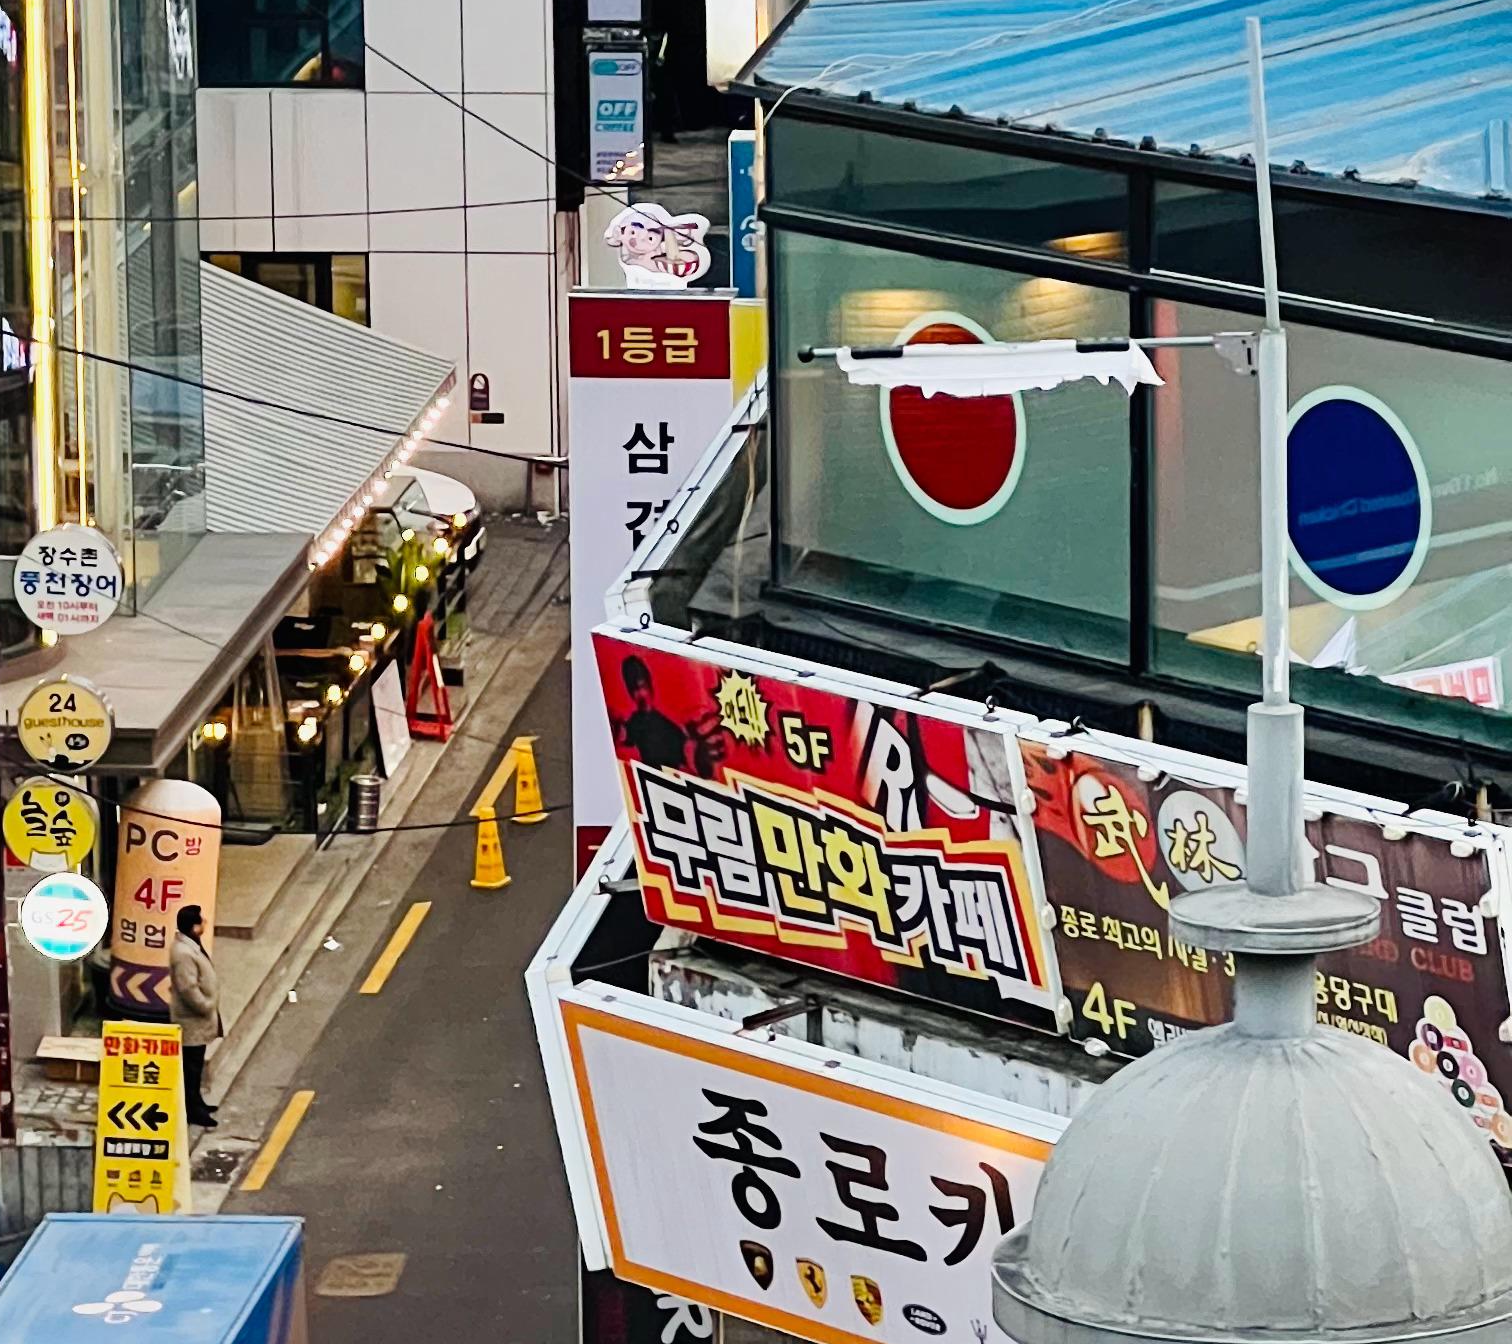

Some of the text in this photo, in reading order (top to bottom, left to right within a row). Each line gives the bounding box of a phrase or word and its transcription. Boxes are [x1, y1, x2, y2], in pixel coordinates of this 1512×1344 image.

[599, 103, 636, 118] OFF
[597, 327, 699, 364] 1등급
[39, 546, 98, 567] 장수촌
[20, 571, 117, 598] 풍천장어
[49, 693, 77, 713] 24
[24, 716, 105, 729] guesthouse
[783, 717, 831, 769] 5F
[126, 822, 202, 861] PC방
[134, 877, 183, 911] 4F
[646, 778, 1019, 976] 무림만화카페
[1061, 905, 1100, 940] 종로
[1101, 916, 1163, 960] 최고의
[1410, 947, 1475, 982] CLUB
[1082, 982, 1136, 1039] 4F
[104, 1036, 180, 1056] 만화카페
